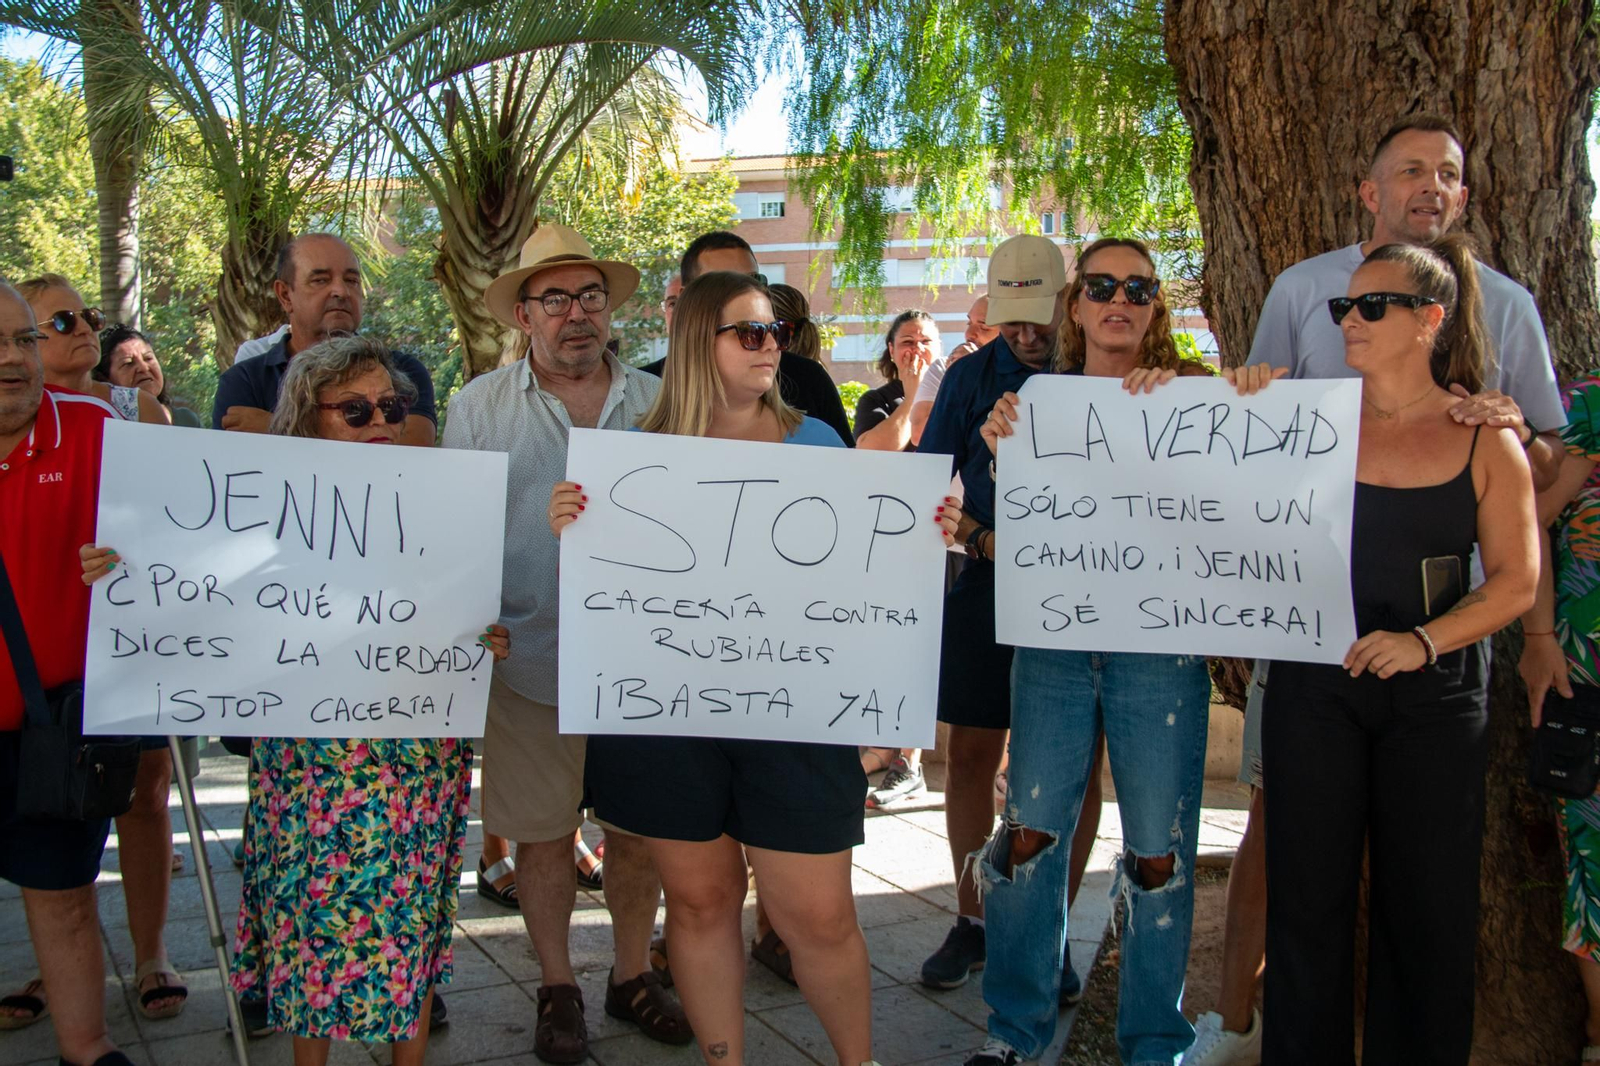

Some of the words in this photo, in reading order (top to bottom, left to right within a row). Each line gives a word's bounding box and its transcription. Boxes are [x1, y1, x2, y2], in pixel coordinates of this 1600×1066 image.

[1030, 402, 1115, 463] LA
[1142, 402, 1338, 466] VERDAD
[39, 472, 63, 484] EAR
[589, 464, 916, 573] STOP
[1003, 485, 1097, 520] SÓLO
[1111, 491, 1225, 522] TIENE
[1256, 488, 1315, 526] UN
[106, 562, 234, 607] ¿POR
[256, 583, 332, 619] QUÉ
[357, 590, 417, 624] NO
[584, 590, 766, 620] CACERÍA
[804, 600, 919, 626] CONTRA
[650, 628, 834, 664] RUBIALES
[1041, 594, 1100, 632] SÉ
[1138, 596, 1323, 646] SINCERA!
[110, 627, 235, 658] DICES
[277, 639, 320, 666] LA
[355, 643, 487, 681] VERDAD?
[156, 682, 283, 725] ¡STOP
[311, 693, 455, 726] CACERÍA!
[595, 673, 794, 720] ¡BASTA
[828, 688, 906, 736] YA!
